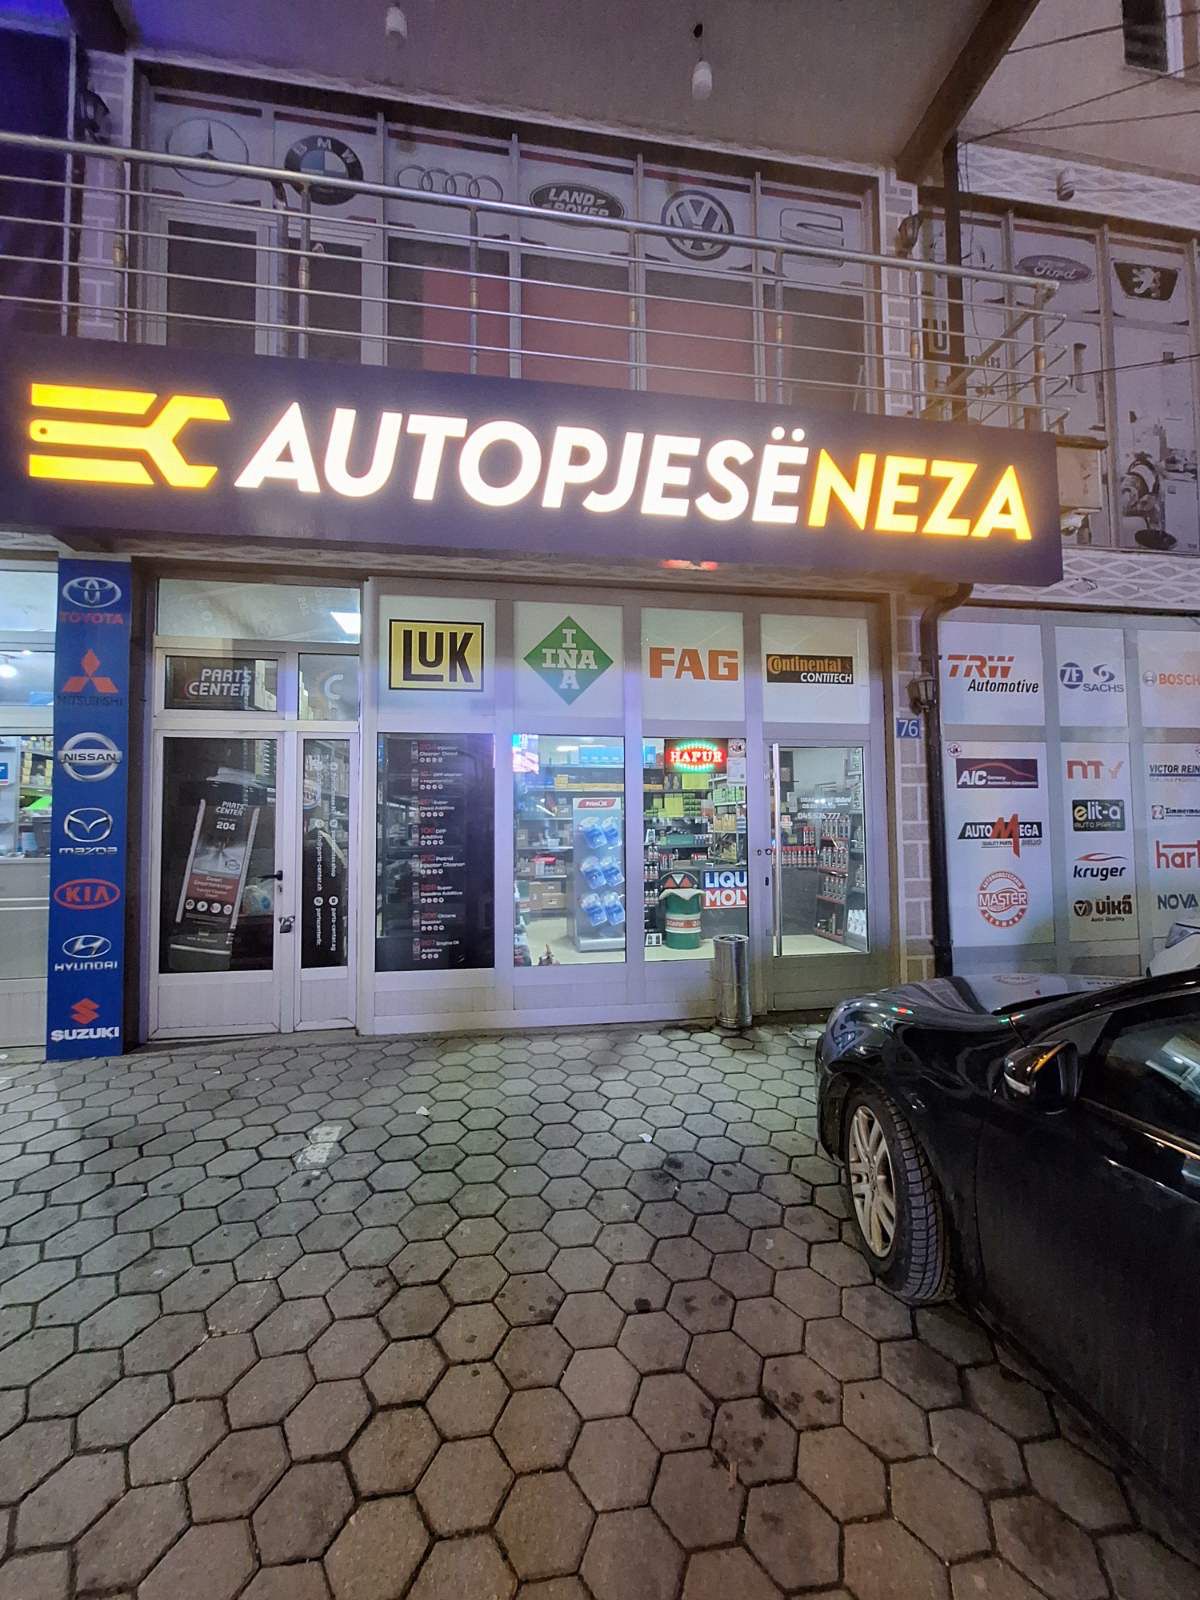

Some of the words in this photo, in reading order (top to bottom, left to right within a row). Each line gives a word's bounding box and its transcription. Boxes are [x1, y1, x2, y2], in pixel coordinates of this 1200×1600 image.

[548, 187, 595, 206] LAND
[1034, 262, 1076, 280] Ford
[60, 611, 124, 625] TOYOTA
[649, 647, 739, 681] FAG
[767, 656, 841, 674] Continental
[947, 655, 1015, 679] TRW
[201, 668, 252, 683] PARTS
[801, 672, 852, 684] CONTITECH
[188, 681, 251, 697] CENTER
[967, 679, 1040, 694] Automotive
[1083, 683, 1125, 693] SACHS
[898, 719, 919, 737] 76
[63, 752, 117, 762] NISSAN
[670, 750, 723, 763] HAPUR
[1149, 764, 1179, 773] VICTOR
[957, 770, 987, 785] AIC
[215, 806, 244, 817] CENTER
[221, 801, 247, 811] PARTS
[216, 821, 236, 831] 204
[1073, 865, 1127, 881] kruger
[66, 886, 111, 901] KIA
[979, 892, 1027, 907] MASTER
[1157, 893, 1199, 910] NOVA
[54, 961, 118, 971] HYUNDAI
[50, 1027, 120, 1042] SUZUKI
